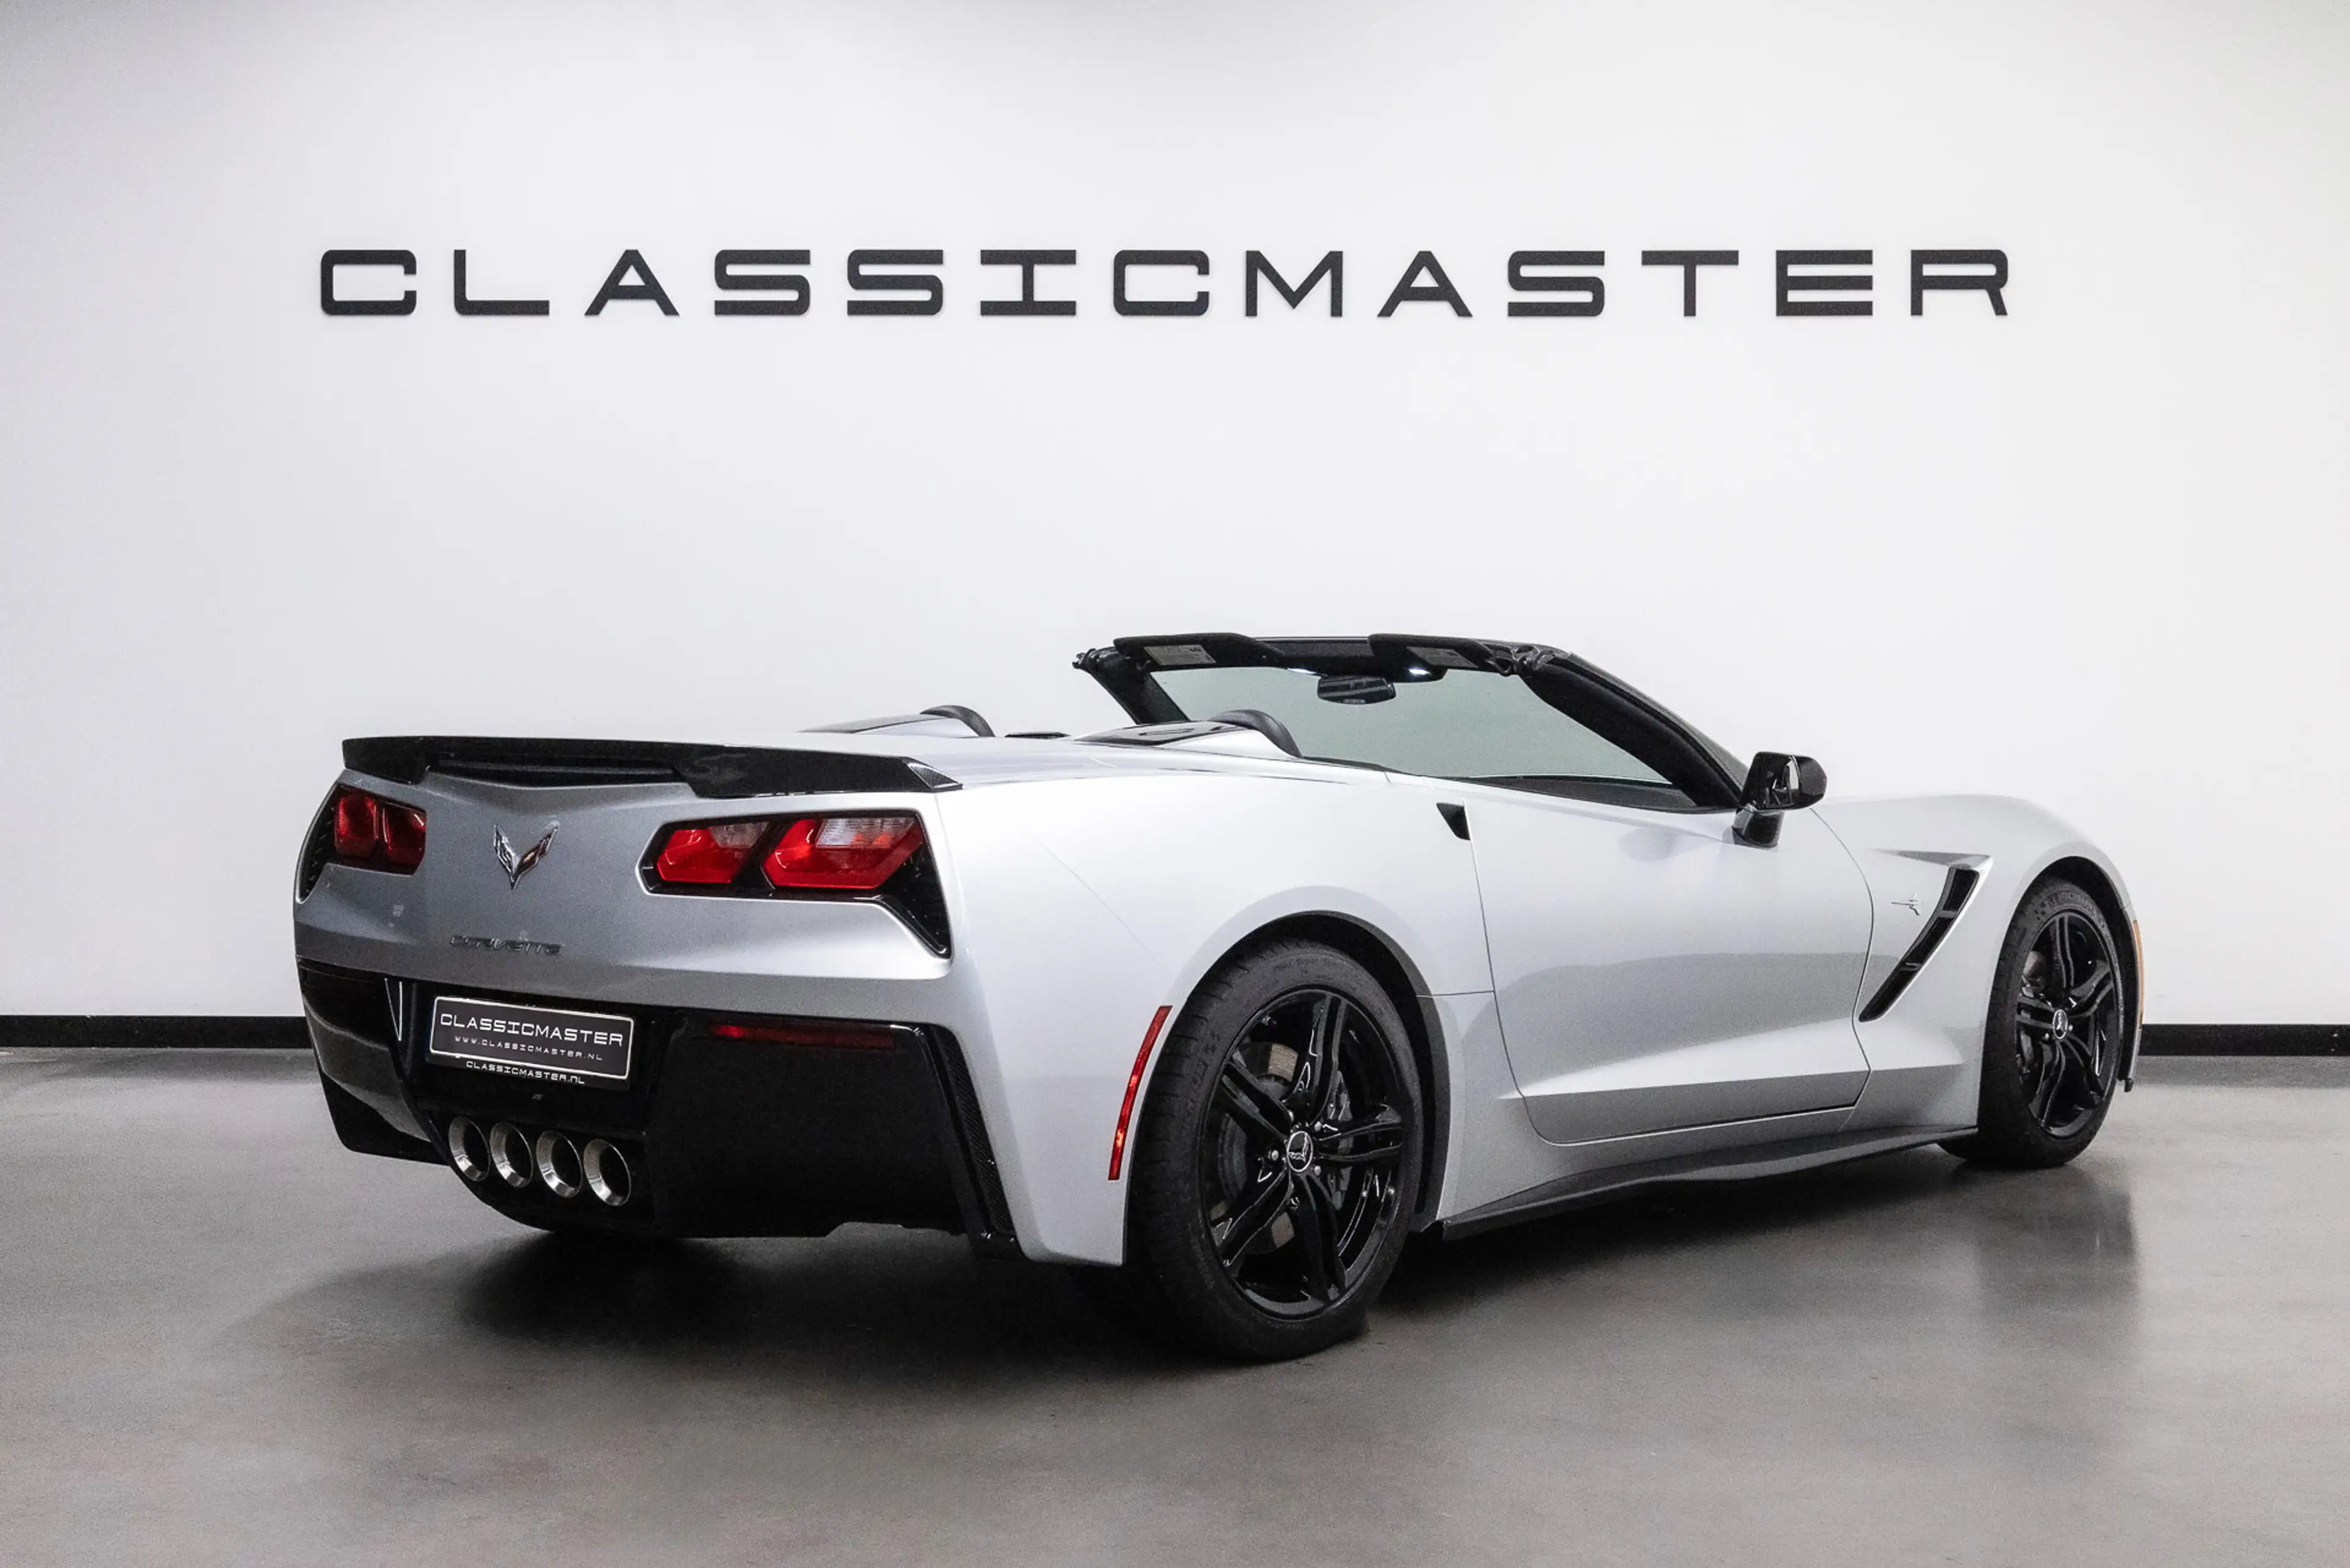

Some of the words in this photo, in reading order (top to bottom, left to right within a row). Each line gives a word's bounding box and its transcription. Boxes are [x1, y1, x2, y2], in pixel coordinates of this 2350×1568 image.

[321, 249, 2008, 316] CLASSICMASTER
[439, 1014, 623, 1047] CLASSICMASTER
[454, 1036, 603, 1061] WWW.CLASSICMASTER.NL
